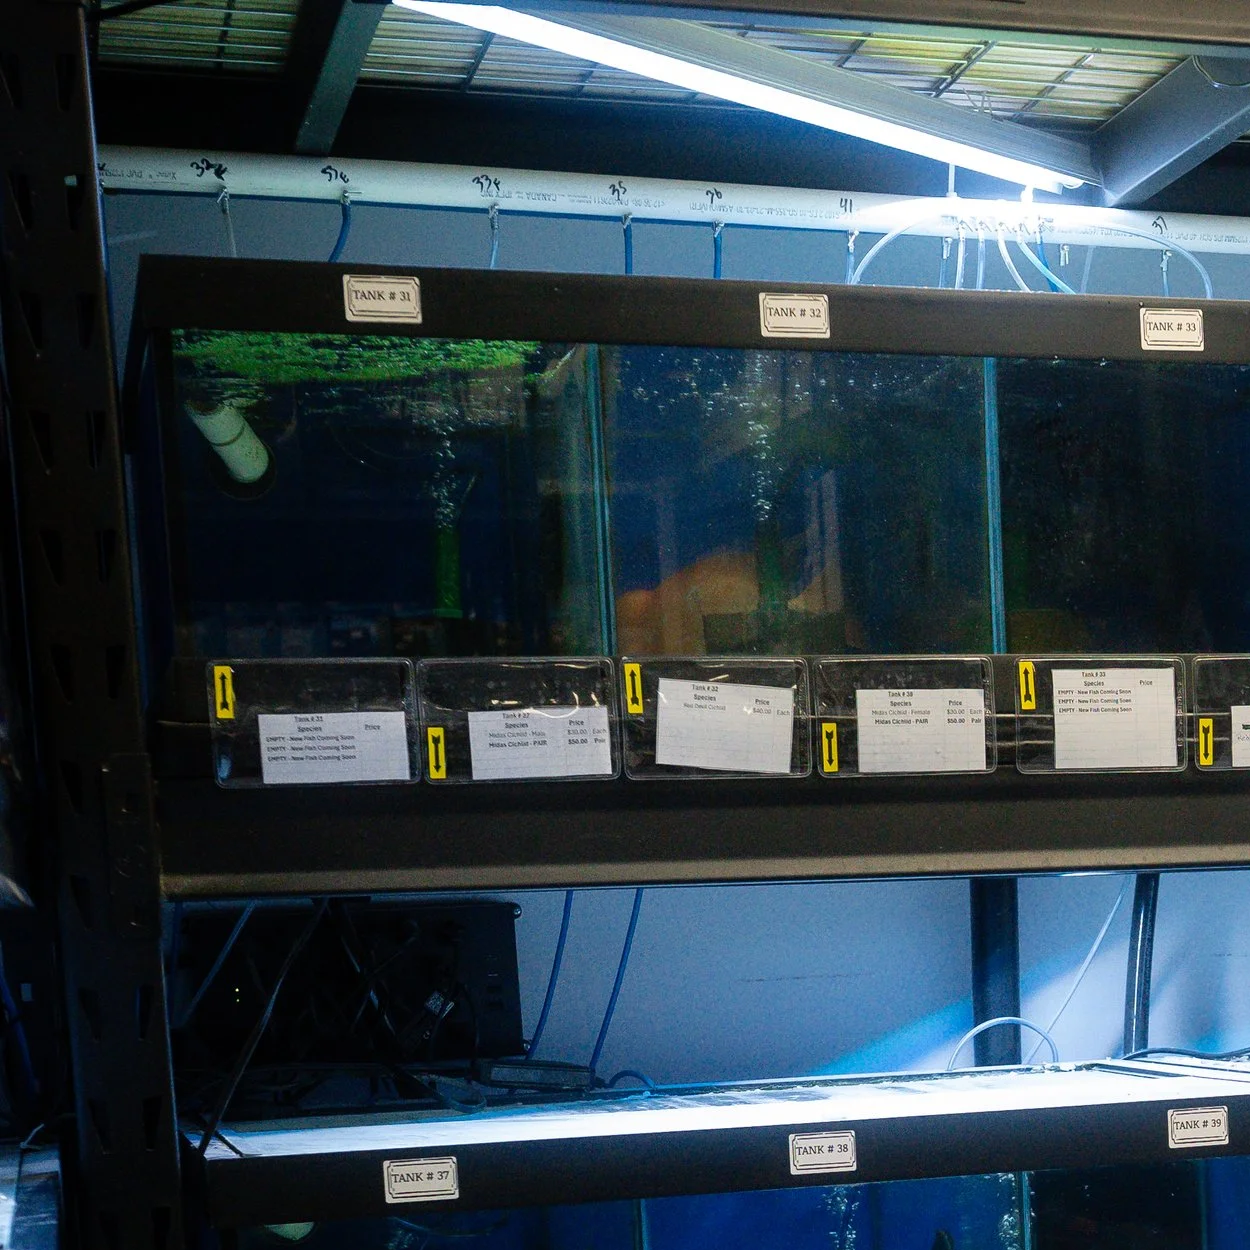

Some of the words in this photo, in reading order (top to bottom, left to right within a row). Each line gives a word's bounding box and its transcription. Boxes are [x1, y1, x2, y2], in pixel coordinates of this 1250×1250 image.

[352, 290, 386, 300] TANK
[389, 291, 396, 300] #
[400, 291, 411, 301] 31
[767, 307, 797, 317] TANK
[800, 308, 806, 317] #
[810, 308, 821, 318] 32
[1147, 322, 1174, 331] TANK
[1177, 323, 1183, 331] #
[1186, 323, 1196, 331] 33
[694, 694, 716, 702] Species
[1174, 1120, 1200, 1130] TANK
[1202, 1120, 1208, 1128] #
[1211, 1118, 1222, 1128] 39
[796, 1145, 824, 1156] TANK
[827, 1144, 834, 1153] #
[837, 1144, 848, 1153] 38
[391, 1172, 424, 1183] TANK
[426, 1172, 434, 1180] #
[437, 1171, 449, 1180] 37
